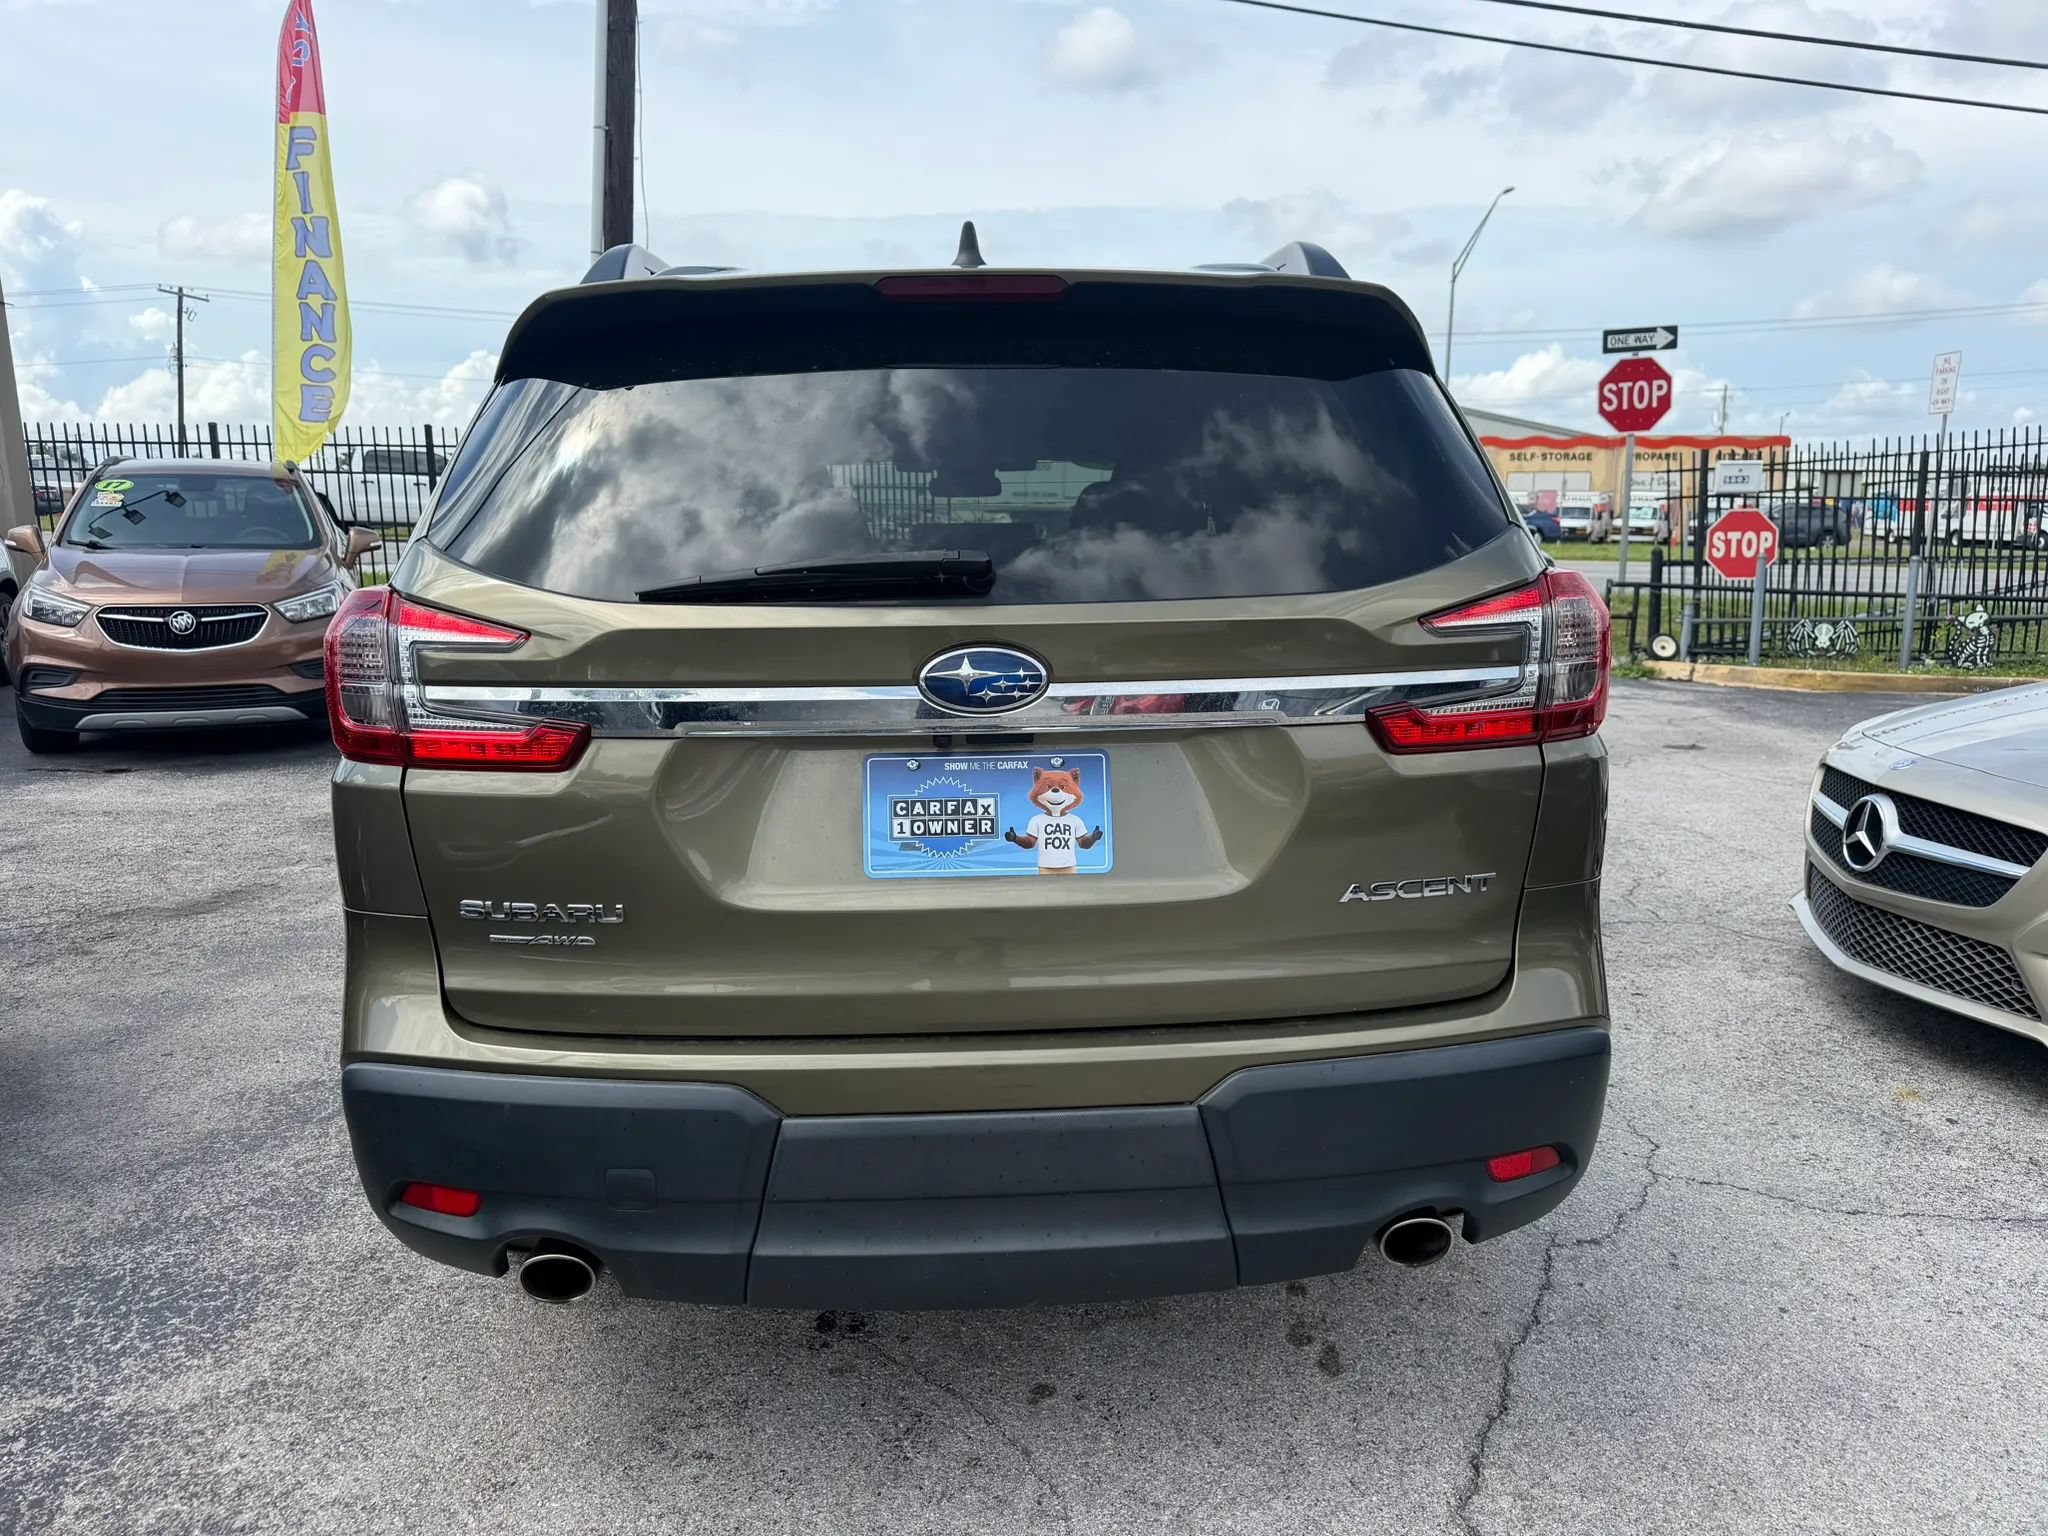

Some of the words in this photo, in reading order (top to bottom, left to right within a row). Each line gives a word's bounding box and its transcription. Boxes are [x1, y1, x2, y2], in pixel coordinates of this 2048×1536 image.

[286, 126, 337, 422] FINANCE
[1610, 335, 1630, 346] ONE
[1634, 333, 1656, 345] WAY
[1602, 379, 1669, 412] STOP
[1509, 452, 1593, 461] SELF-STORAGE
[1634, 451, 1679, 461] ROPANE
[102, 481, 128, 489] 17
[1711, 531, 1774, 559] STOP
[944, 762, 968, 771] SHOW
[969, 762, 980, 771] ME
[981, 762, 996, 770] THE
[997, 760, 1029, 770] CARFAX
[895, 802, 992, 816] CARFAX
[897, 821, 907, 835] 1
[912, 820, 992, 835] OWNER
[1044, 822, 1072, 837] CAR
[1044, 836, 1070, 850] FOX
[1338, 872, 1497, 903] ASCENT
[459, 899, 624, 924] SUBARU
[528, 935, 596, 946] AWD
